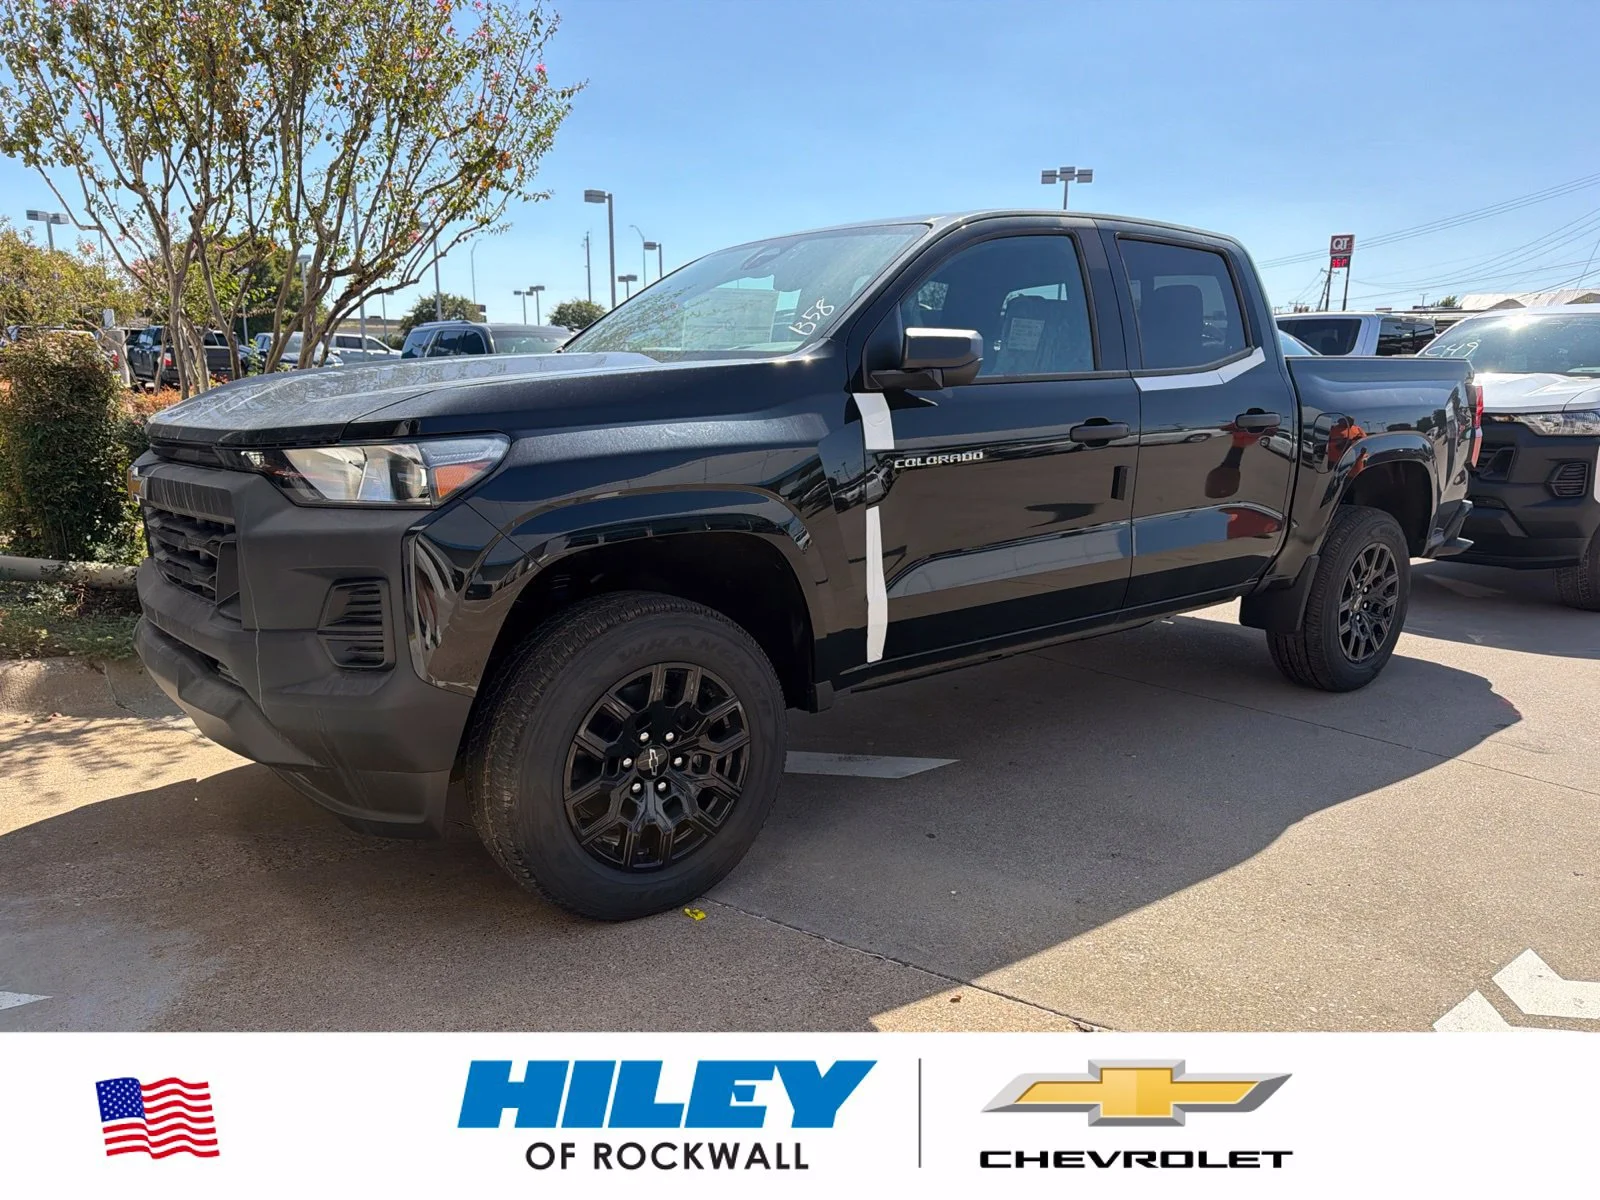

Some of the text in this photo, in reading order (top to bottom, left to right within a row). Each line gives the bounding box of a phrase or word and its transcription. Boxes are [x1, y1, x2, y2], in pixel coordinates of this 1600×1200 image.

[1333, 238, 1350, 250] QT
[788, 297, 835, 336] B58
[894, 451, 984, 469] COLORADO
